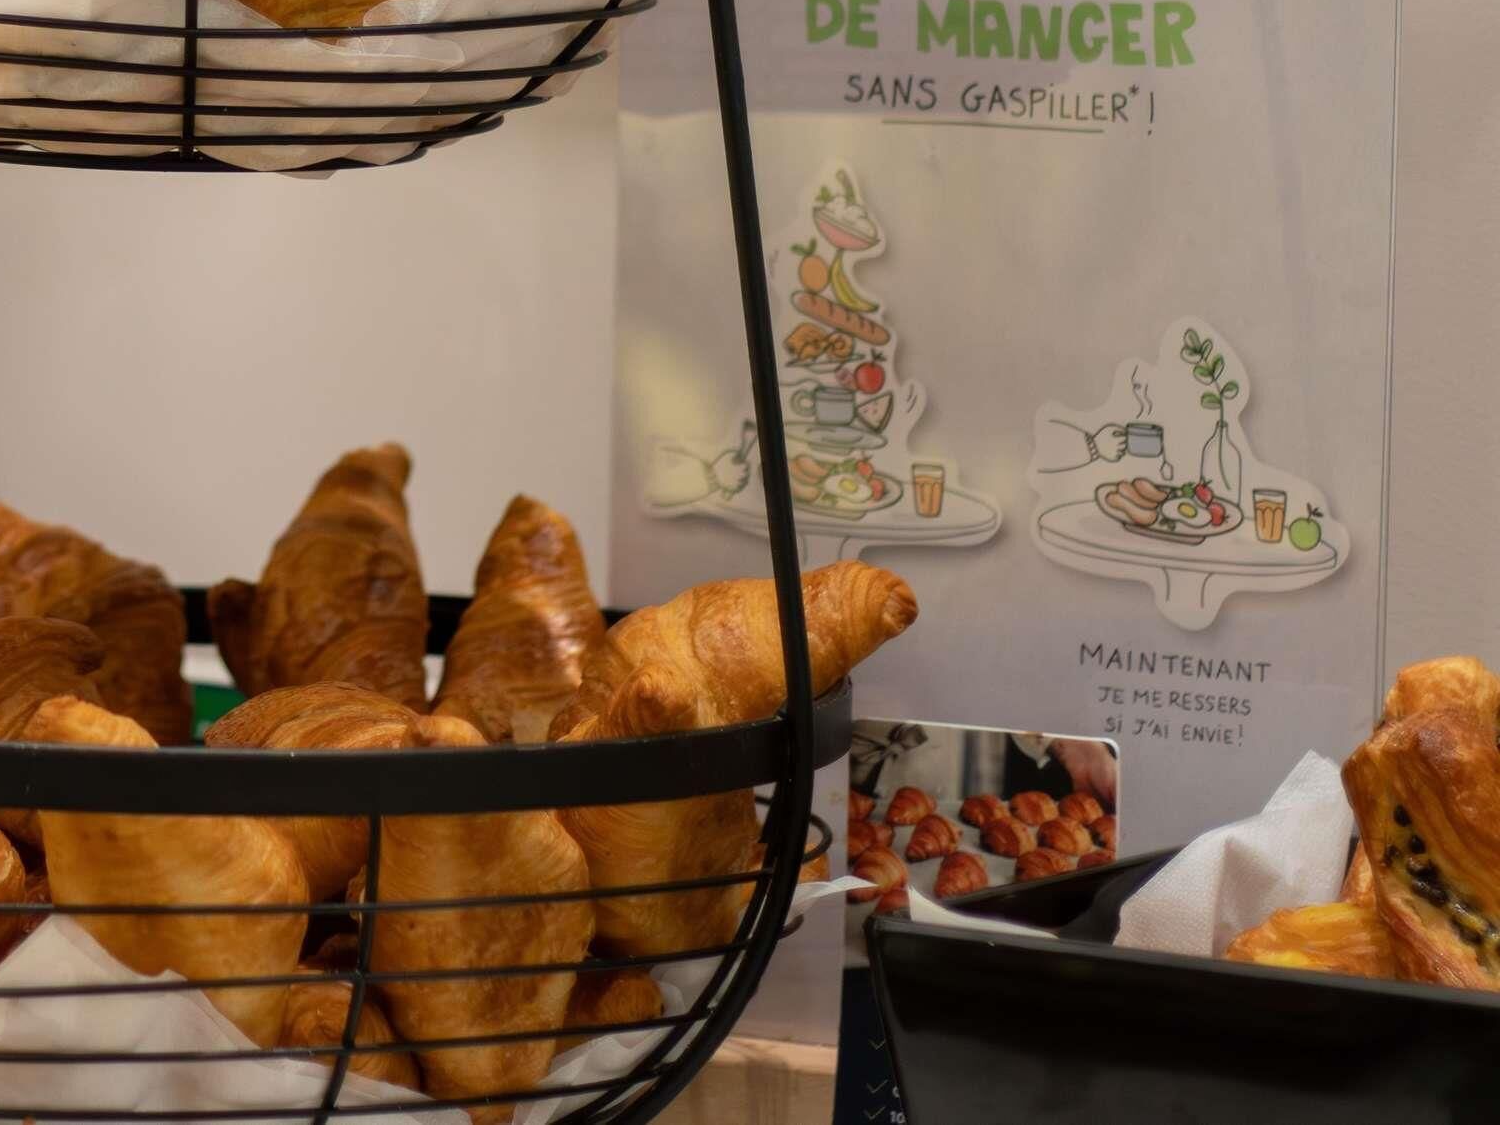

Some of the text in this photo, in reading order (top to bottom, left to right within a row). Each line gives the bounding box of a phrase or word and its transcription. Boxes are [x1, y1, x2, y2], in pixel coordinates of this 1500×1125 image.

[844, 75, 937, 111] SANS
[1079, 643, 1272, 683] MAINTENANT
[1098, 686, 1252, 716] JE ME RESSERS
